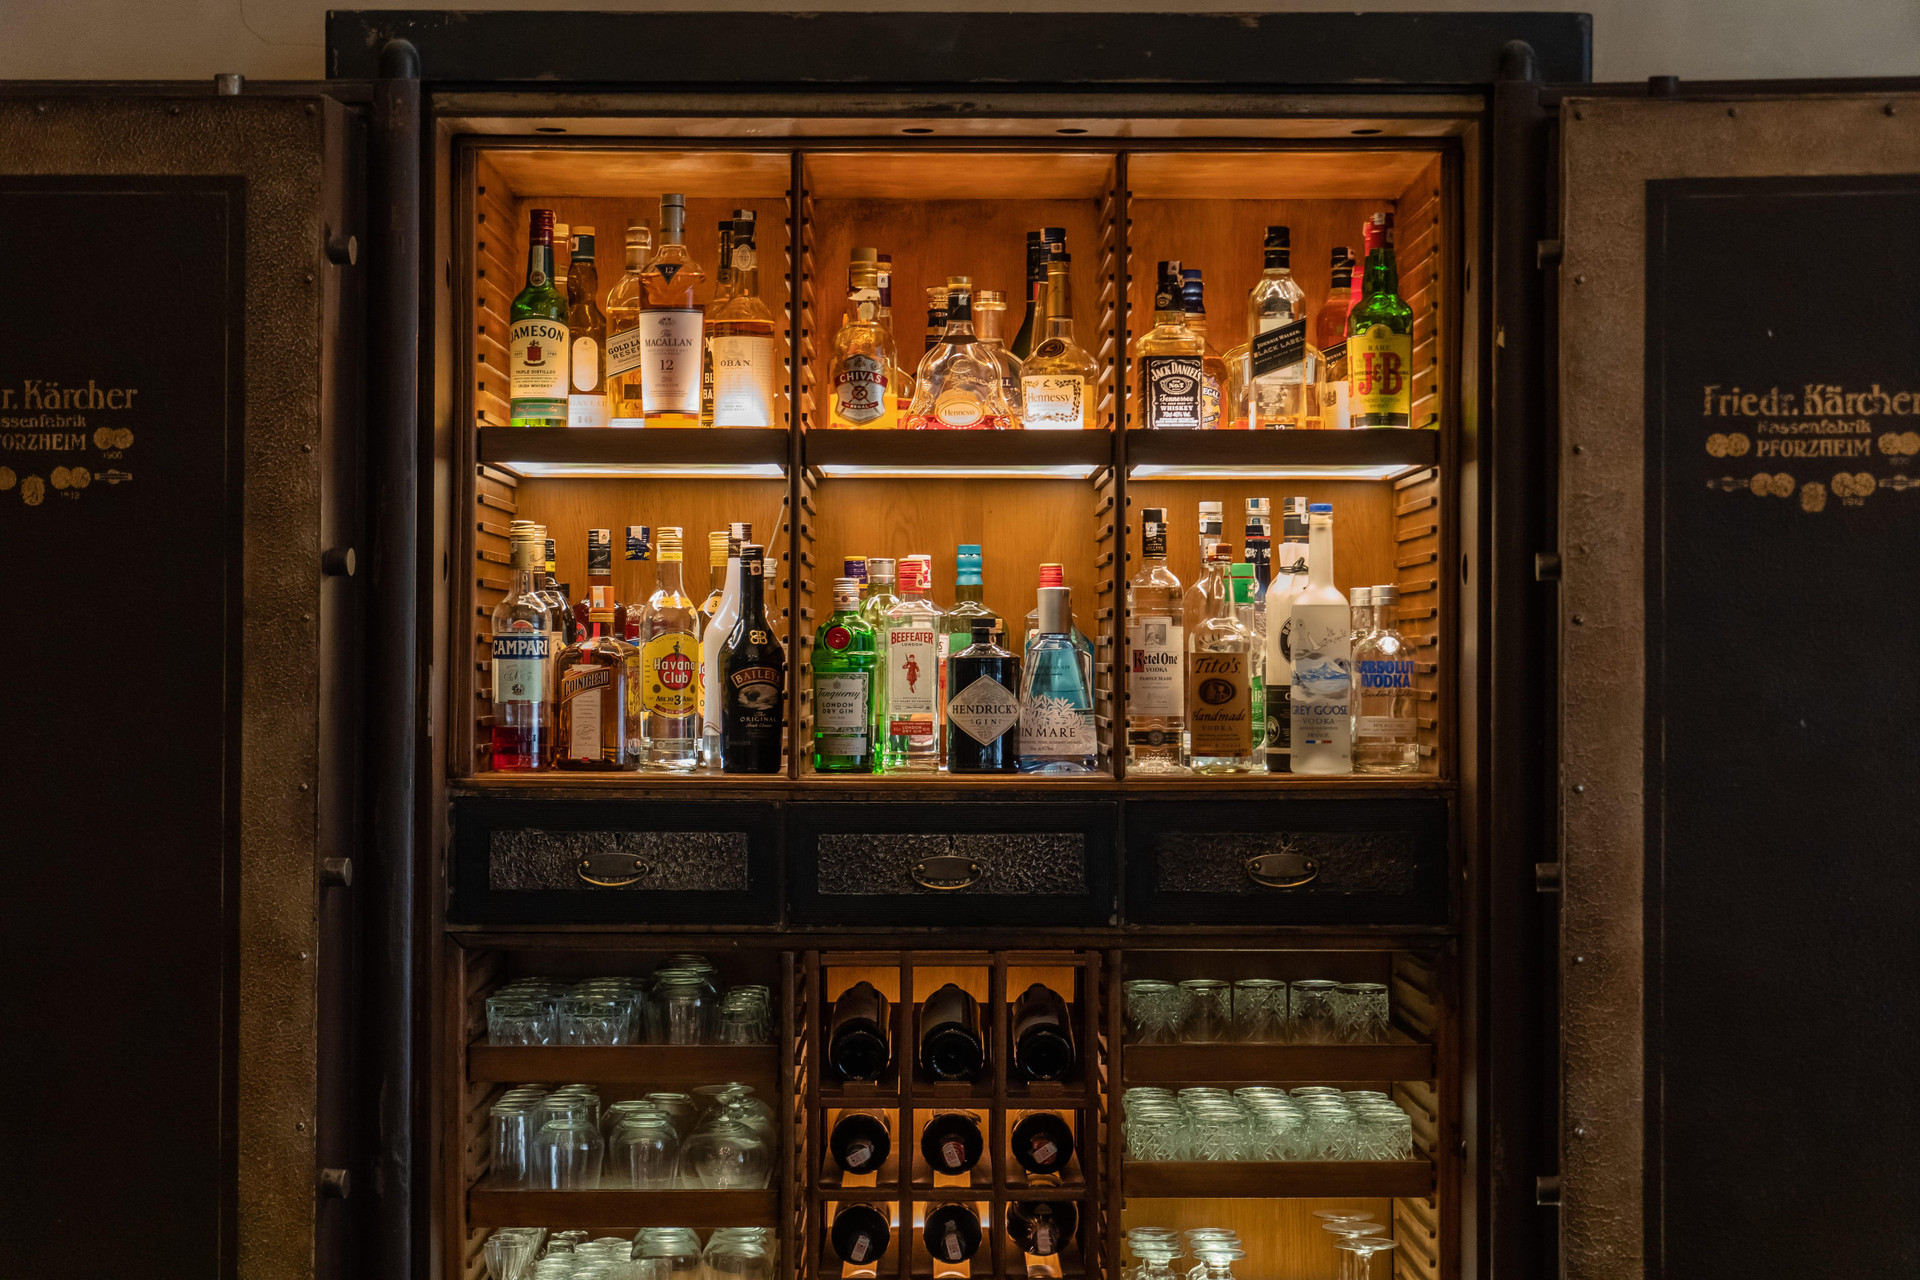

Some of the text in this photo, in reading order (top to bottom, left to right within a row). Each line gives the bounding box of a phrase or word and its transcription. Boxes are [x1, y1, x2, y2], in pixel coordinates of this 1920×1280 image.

[664, 265, 674, 275] 12
[510, 325, 565, 344] JAMESON
[607, 342, 630, 355] GOLD
[644, 338, 692, 347] MACALLAN
[1253, 335, 1305, 359] BLACK LABEL
[659, 359, 674, 371] 12
[1150, 361, 1202, 382] JACK DANIEL'S
[840, 371, 882, 383] CHIVAS
[24, 379, 139, 410] Kärcher
[1027, 392, 1071, 405] Hennessy
[1159, 393, 1194, 402] Tennessee
[1703, 385, 1799, 416] Friedr.
[944, 408, 976, 418] Hennessy
[1757, 418, 1872, 434] Kassenfabrik
[0, 433, 87, 451] ORZHEIM
[1756, 438, 1871, 458] PFORZHEIM
[891, 632, 934, 645] BEEFEATER
[492, 640, 549, 656] CAMPARI
[653, 657, 696, 671] Havana
[1133, 652, 1178, 669] Ketel One
[1195, 656, 1241, 674] Tito's
[1359, 660, 1415, 674] ABSOLUT
[663, 671, 689, 684] Club
[735, 670, 780, 684] BAILEYS
[1363, 674, 1411, 688] VODKA
[563, 671, 610, 698] COINTREAU
[674, 694, 682, 706] 3
[817, 687, 861, 700] Tanqueray
[952, 704, 1018, 715] HENDRICK'S
[1192, 708, 1246, 721] Handmade
[1292, 703, 1348, 716] GREY GOOSE
[975, 718, 997, 726] GIN
[1301, 717, 1336, 725] VODKA
[1019, 727, 1077, 738] IN MARE
